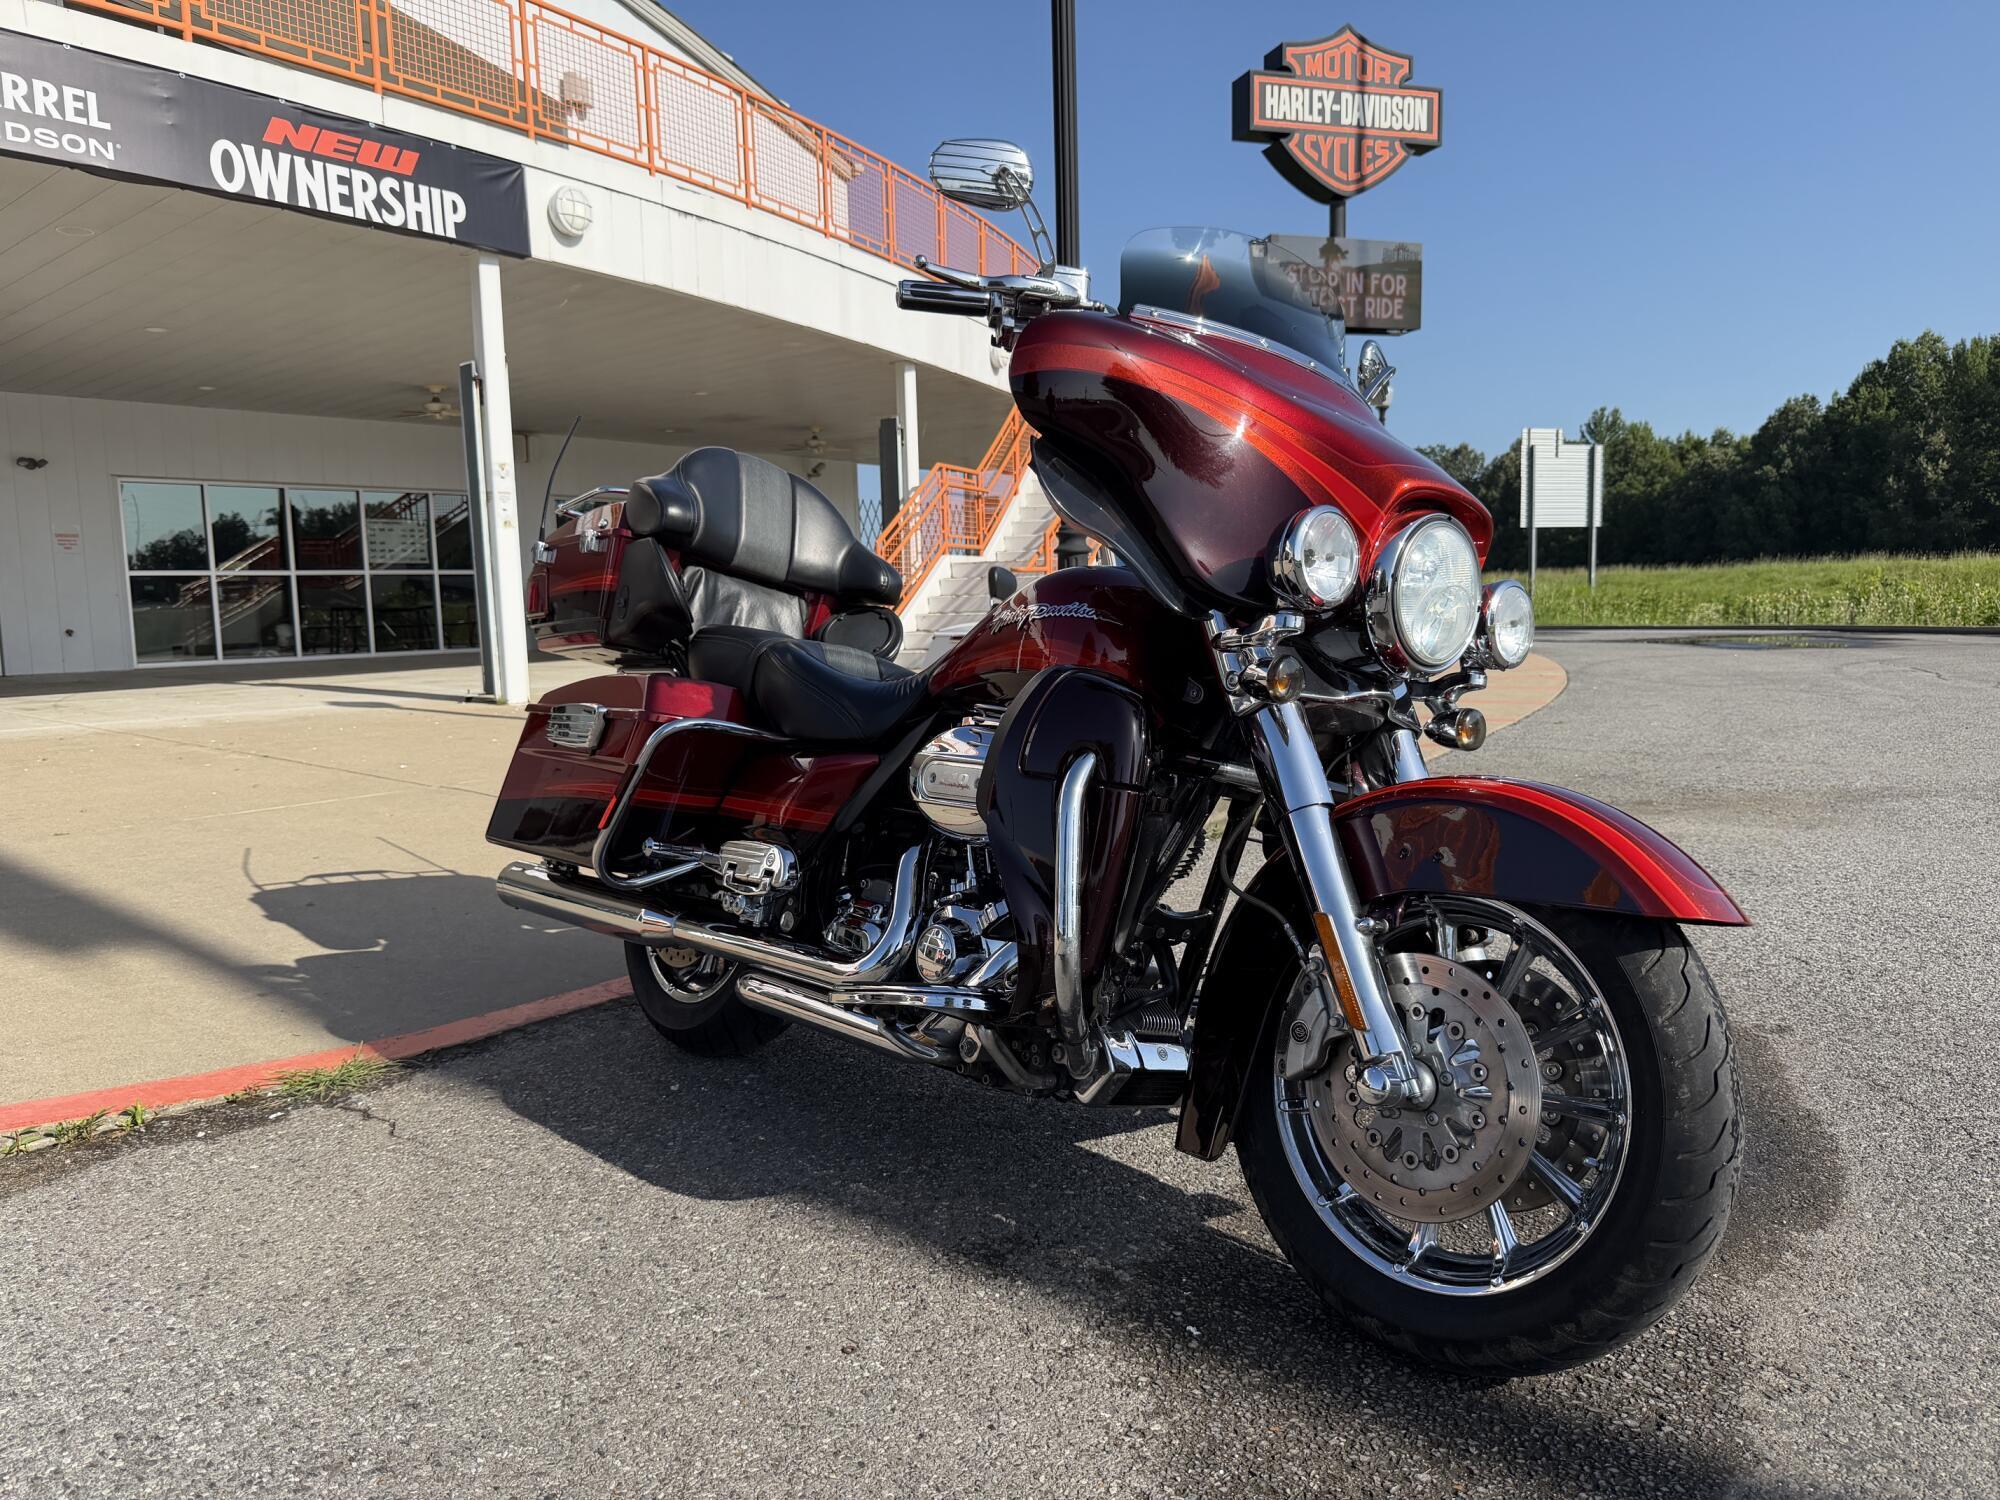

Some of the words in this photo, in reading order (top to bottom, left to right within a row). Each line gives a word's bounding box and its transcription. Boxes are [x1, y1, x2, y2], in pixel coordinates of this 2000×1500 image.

[1305, 41, 1391, 85] MOTOR
[0, 71, 111, 130] RREL
[1265, 84, 1428, 132] HARLEY-DAVIDSON
[0, 120, 115, 160] DSON
[262, 116, 420, 176] NEW
[1304, 134, 1390, 181] CYCLES
[209, 139, 467, 239] OWNERSHIP
[1346, 271, 1364, 295] IN
[1370, 273, 1407, 297] FOR
[1365, 299, 1404, 320] RIDE
